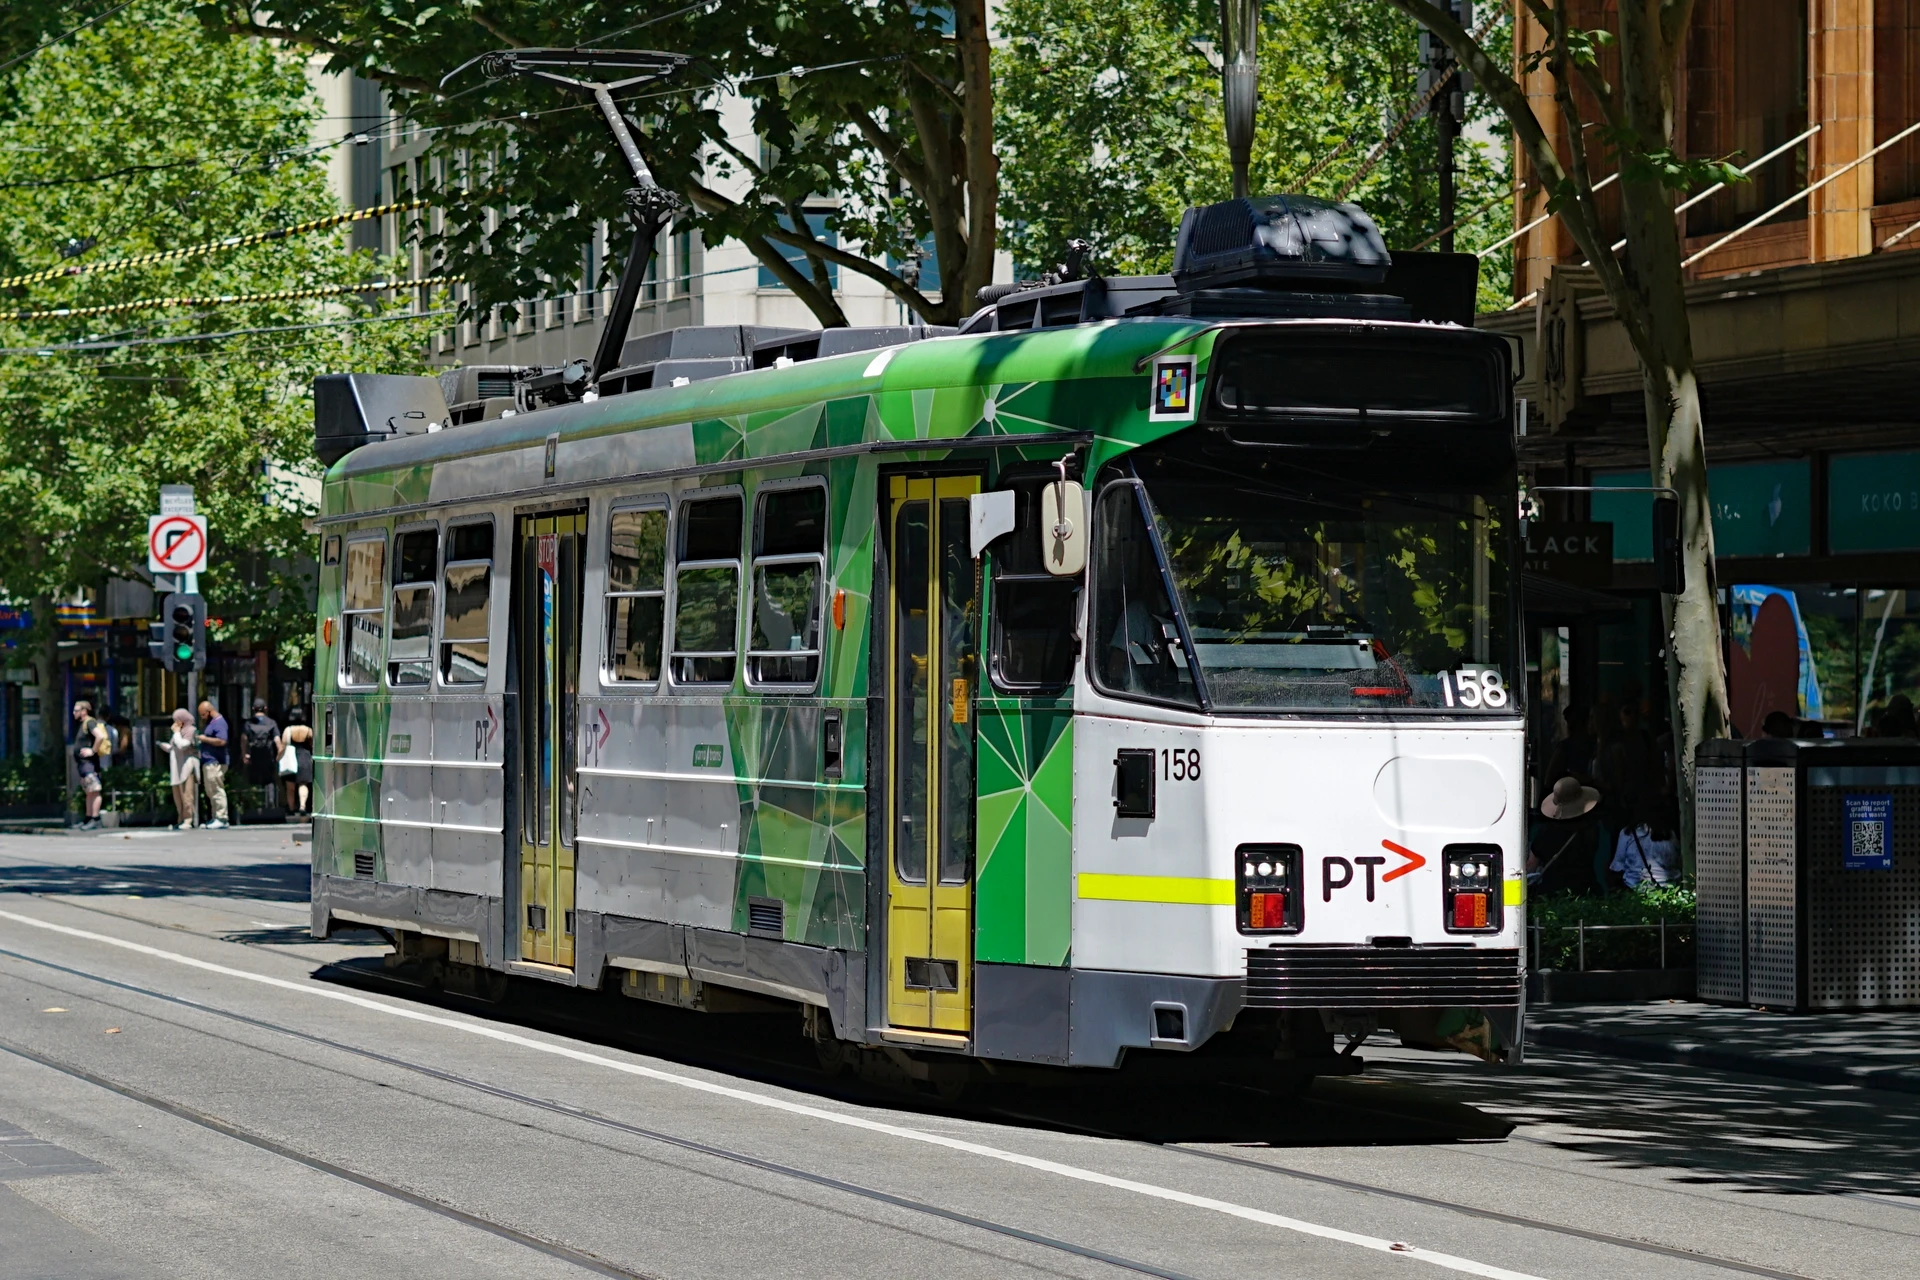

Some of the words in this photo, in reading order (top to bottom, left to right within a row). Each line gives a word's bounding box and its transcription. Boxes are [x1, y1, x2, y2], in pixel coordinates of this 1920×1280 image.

[1861, 492, 1902, 512] KOKO
[538, 537, 554, 564] STOP
[1437, 669, 1507, 708] 158
[1161, 748, 1202, 782] 158
